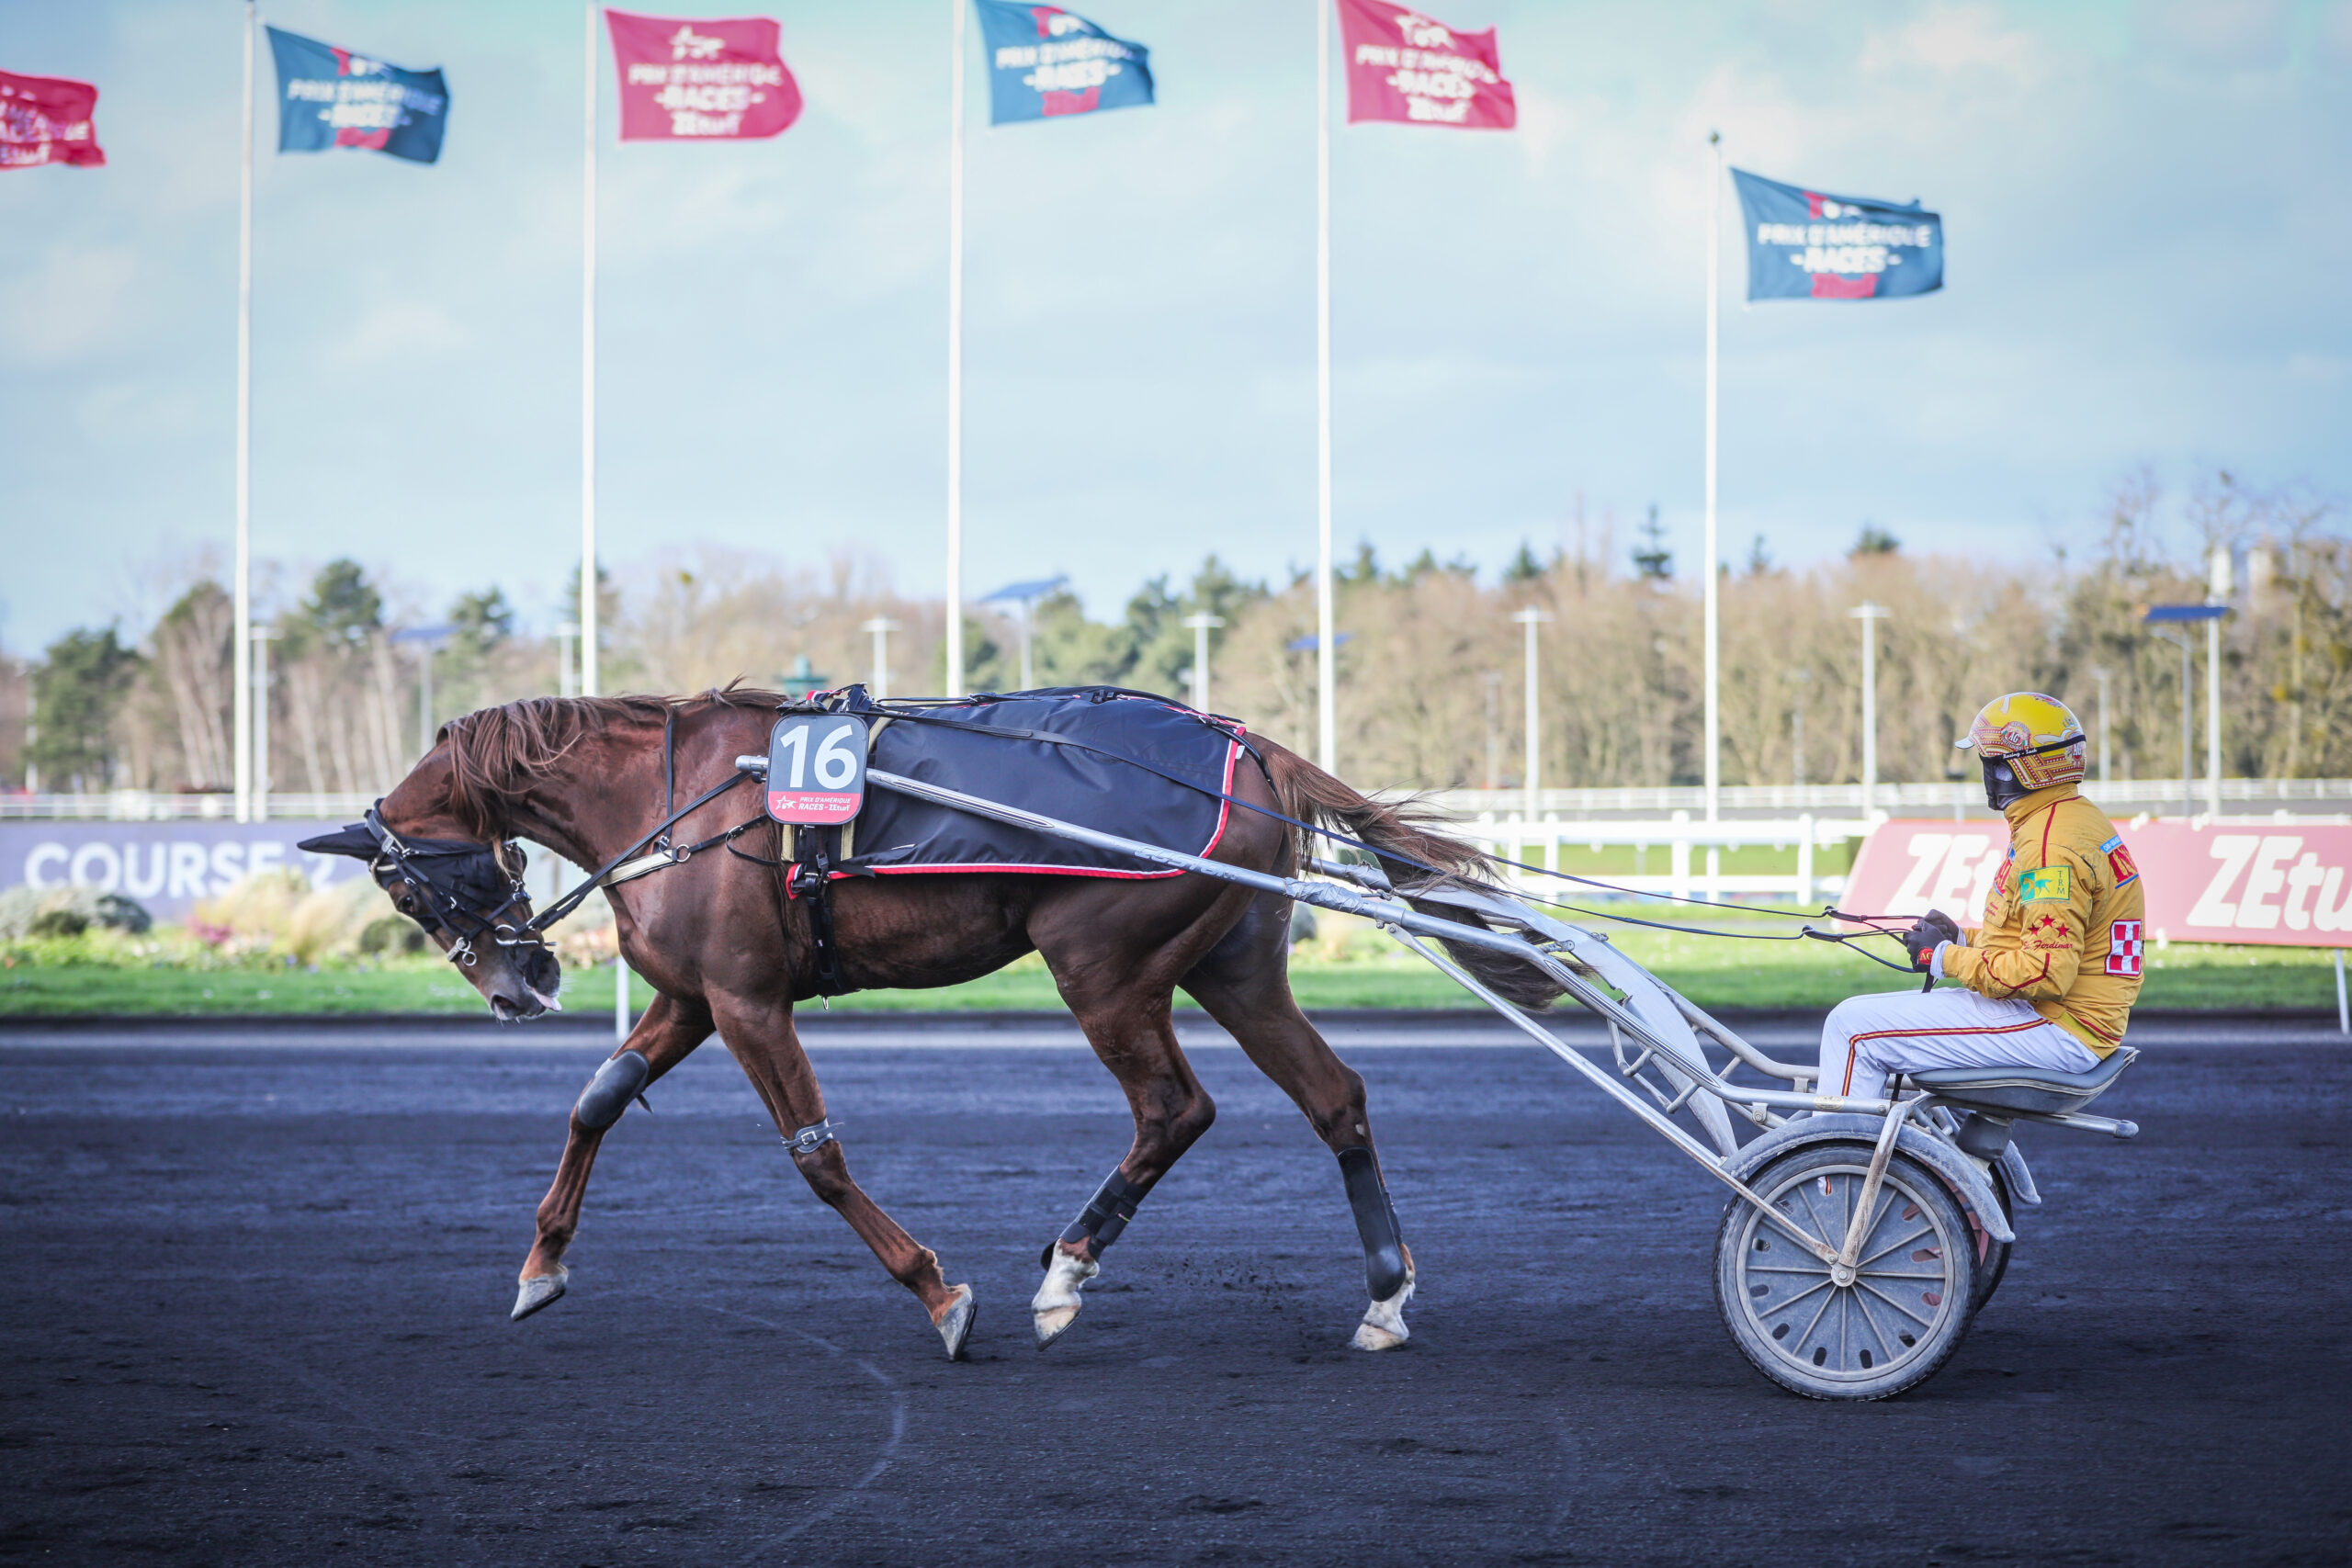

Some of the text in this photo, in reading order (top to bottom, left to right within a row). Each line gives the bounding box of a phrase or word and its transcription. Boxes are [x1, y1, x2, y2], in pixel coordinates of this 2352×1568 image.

[2007, 731, 2020, 743] AG
[780, 724, 857, 790] 16
[815, 795, 852, 804] D'AMÉRIQUE
[798, 803, 825, 811] RACES
[829, 804, 852, 812] ZEturf
[24, 840, 285, 899] COURSE
